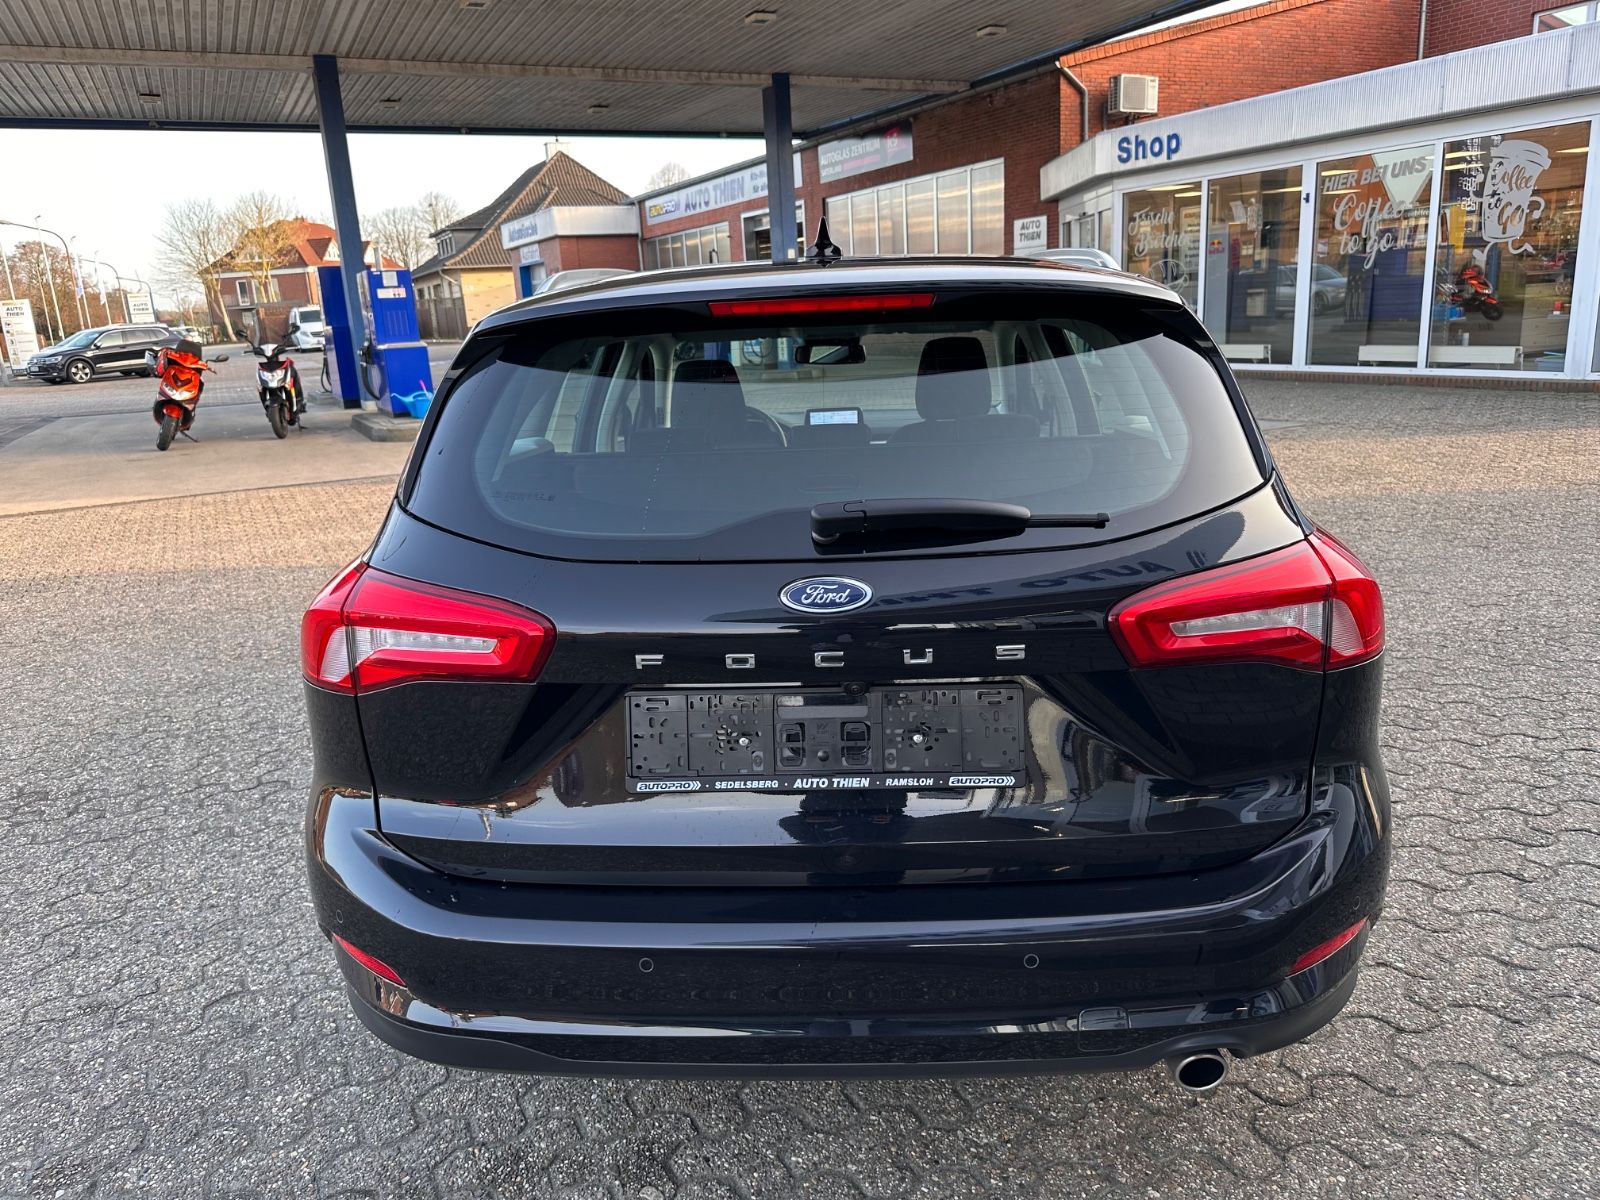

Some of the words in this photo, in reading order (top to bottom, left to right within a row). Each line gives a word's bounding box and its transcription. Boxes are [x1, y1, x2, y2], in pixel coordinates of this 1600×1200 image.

[1117, 132, 1182, 164] Shop
[1323, 172, 1358, 193] HIER
[1360, 165, 1390, 185] BEI
[1391, 156, 1427, 178] UNS
[684, 186, 711, 213] AUTO
[712, 176, 745, 206] THIEN
[1020, 219, 1041, 231] AUTO
[1334, 193, 1404, 238] Coffee
[1019, 230, 1042, 242] THIEN
[1339, 231, 1361, 255] to
[801, 584, 851, 604] Ford
[715, 780, 779, 789] SEDELSBERG
[793, 778, 828, 789] AUTO
[832, 777, 870, 788] THIEN
[885, 778, 934, 787] RAMSLOH
